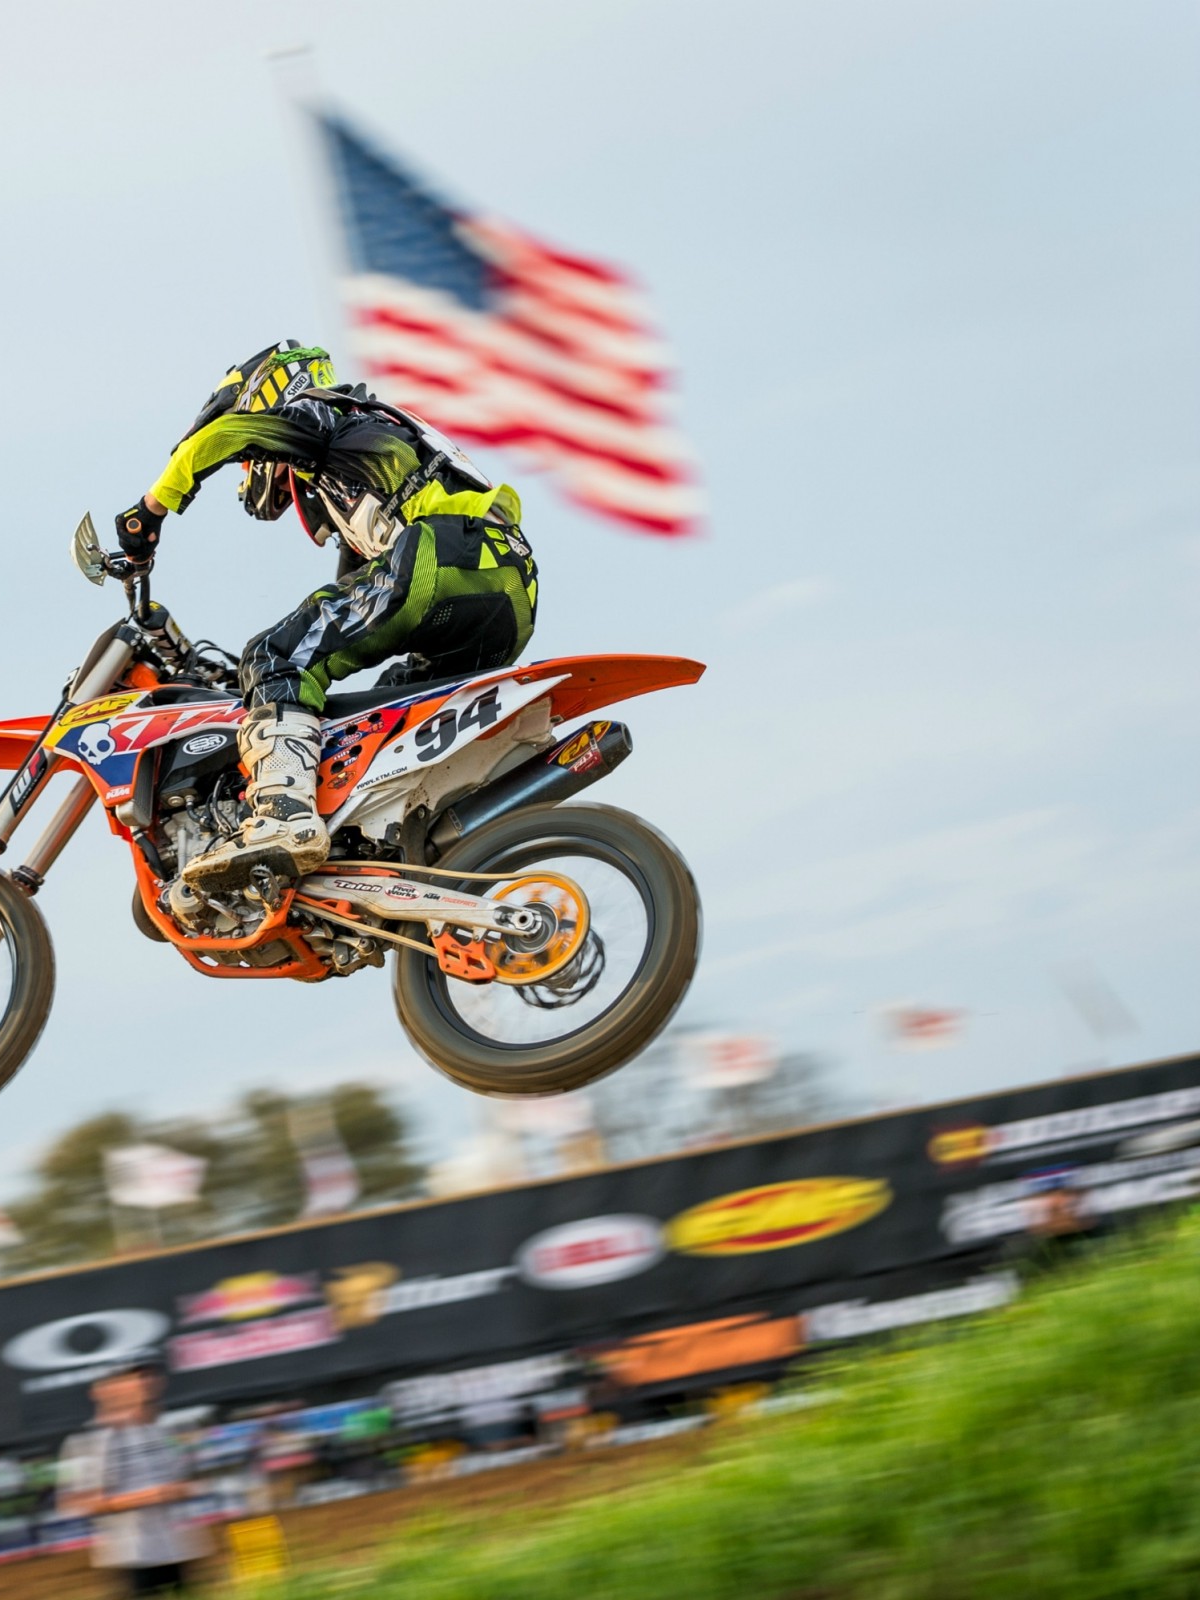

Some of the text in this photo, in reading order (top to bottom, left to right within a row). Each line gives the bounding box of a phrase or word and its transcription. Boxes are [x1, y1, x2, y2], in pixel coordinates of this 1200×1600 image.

[287, 375, 308, 397] SHOEI
[59, 697, 134, 727] FMF
[415, 685, 502, 762] 94
[12, 752, 42, 801] WP
[105, 787, 130, 800] KTM
[334, 879, 383, 893] Talon
[392, 884, 416, 893] Pivot
[387, 889, 418, 899] Works
[423, 892, 441, 900] KTM
